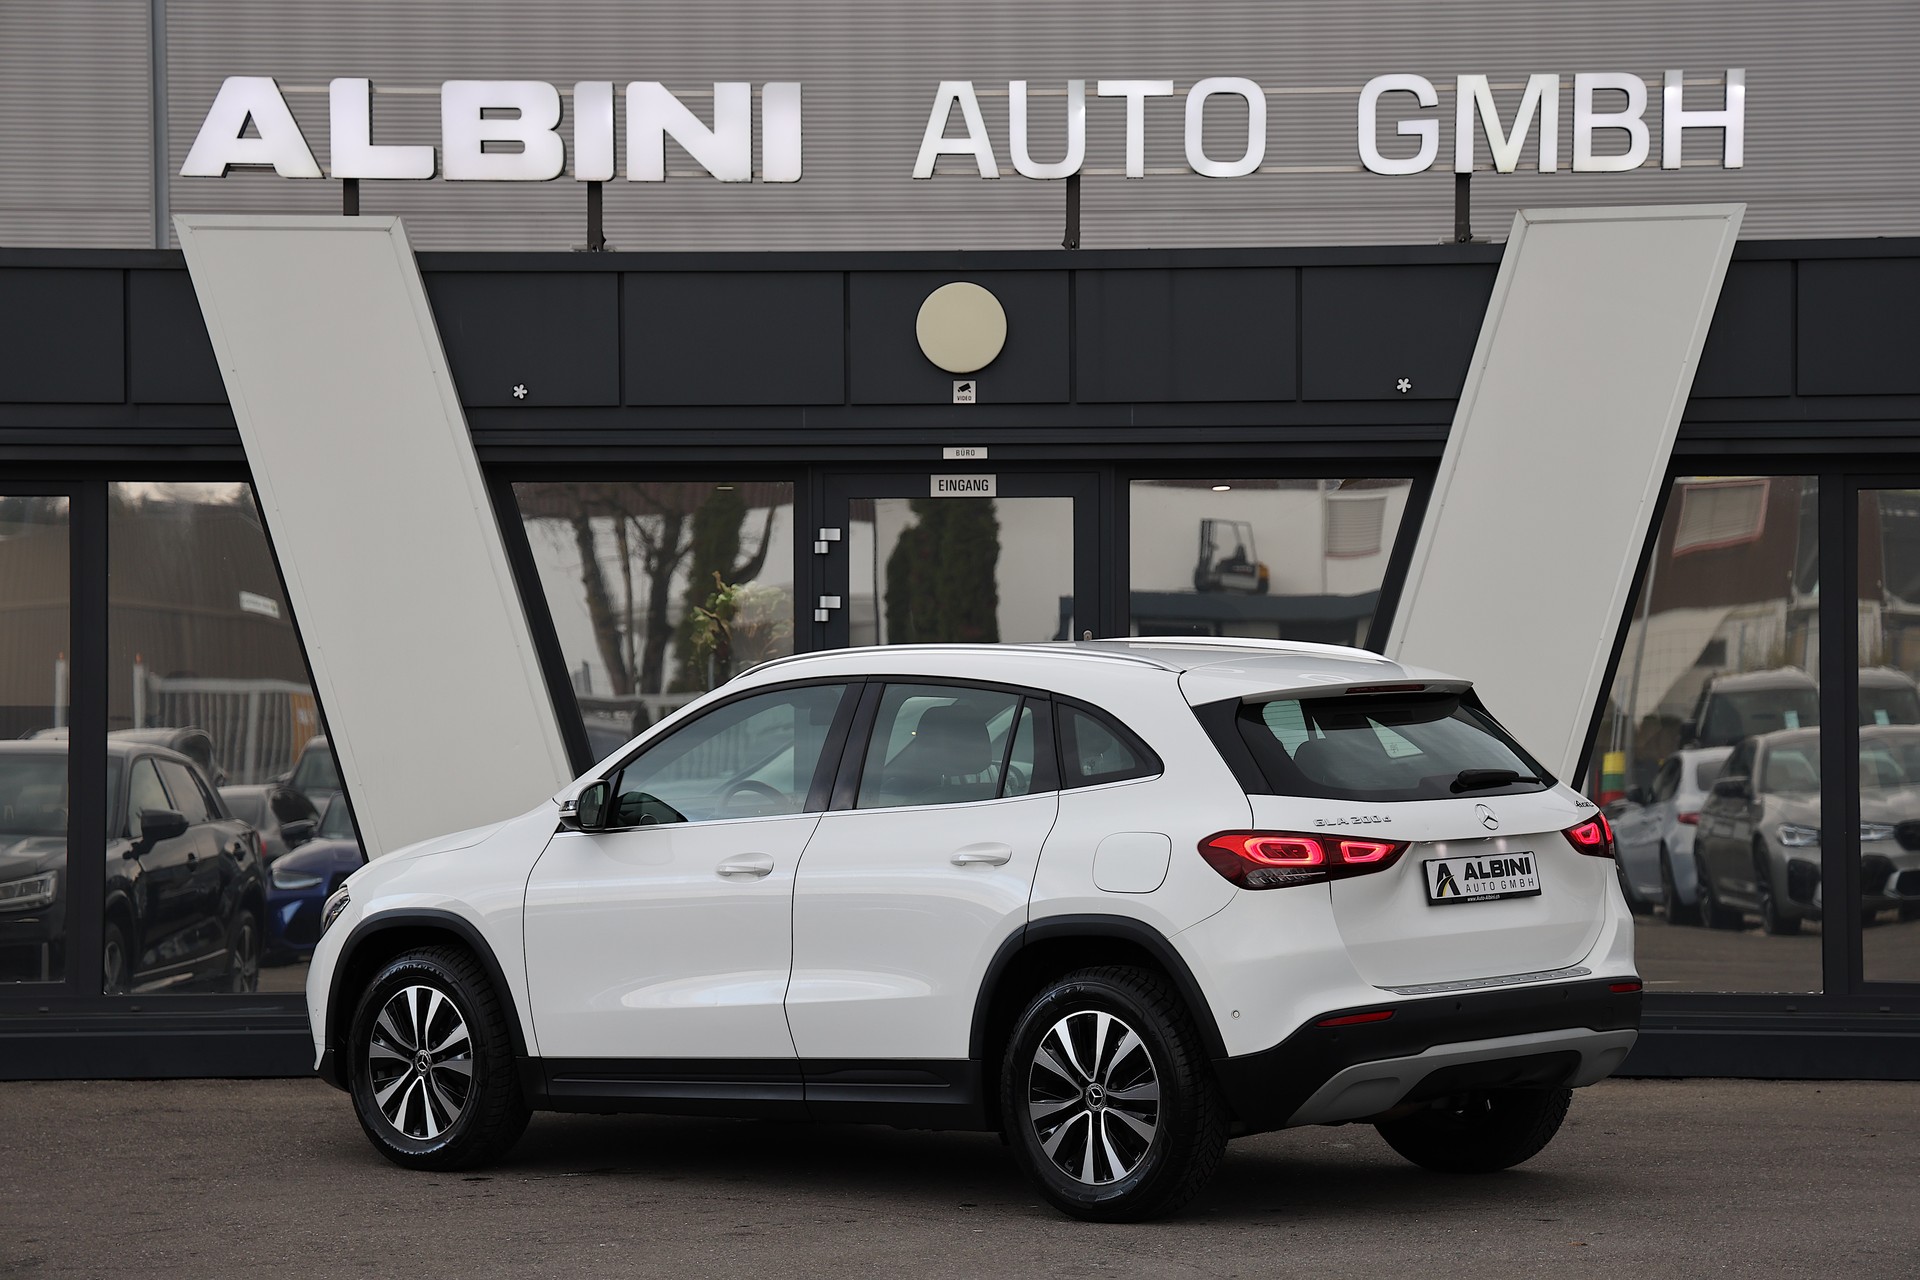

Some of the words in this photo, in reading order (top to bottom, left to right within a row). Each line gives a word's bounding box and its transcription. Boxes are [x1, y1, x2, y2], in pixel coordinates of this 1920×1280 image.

[179, 76, 803, 184] ALBINI
[912, 77, 1266, 180] AUTO
[1357, 68, 1746, 176] GMBH
[955, 448, 976, 457] BÜRO
[938, 479, 989, 492] EINGANG
[1313, 818, 1349, 827] GLA
[1464, 857, 1532, 881] ALBINI
[1466, 881, 1496, 893] AUTO
[1500, 878, 1535, 890] GMBH
